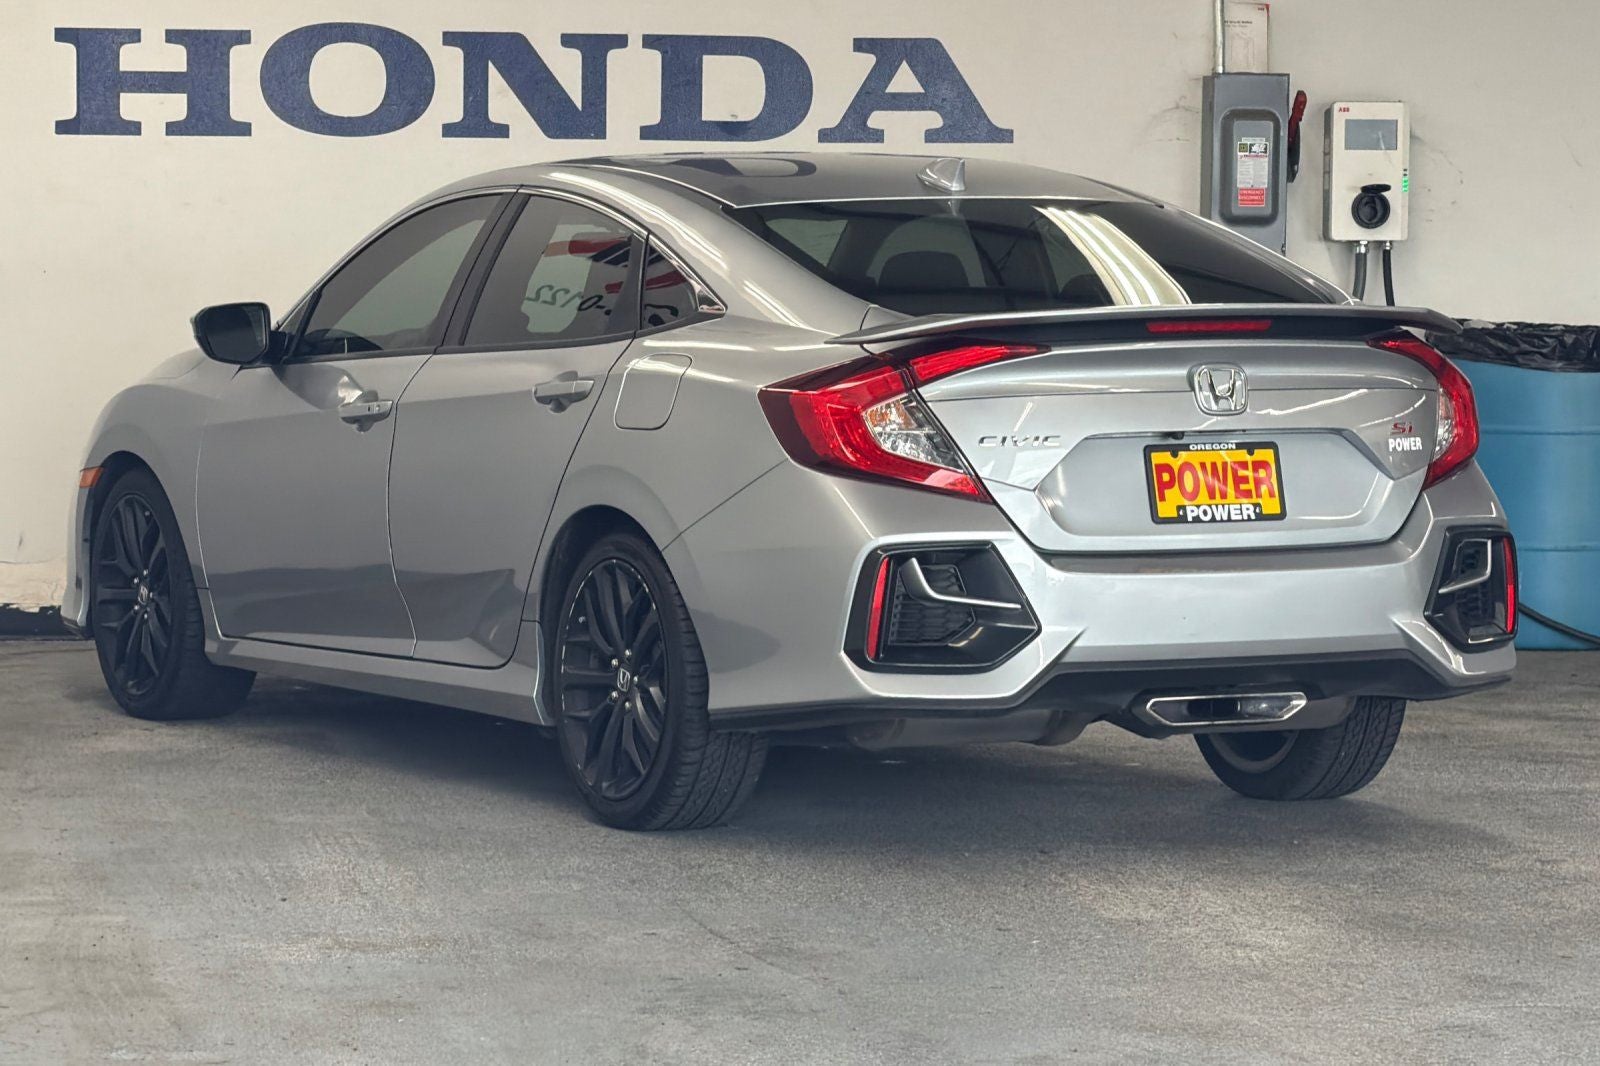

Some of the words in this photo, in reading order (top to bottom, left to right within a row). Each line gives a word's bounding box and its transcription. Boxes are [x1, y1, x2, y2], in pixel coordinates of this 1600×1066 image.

[54, 21, 1014, 144] HONDA
[1391, 422, 1413, 434] Si
[978, 435, 1062, 447] CIVIC
[1189, 443, 1237, 451] OREGON
[1388, 437, 1423, 452] POWER
[1154, 460, 1277, 502] POWER
[1186, 504, 1256, 522] POWER
